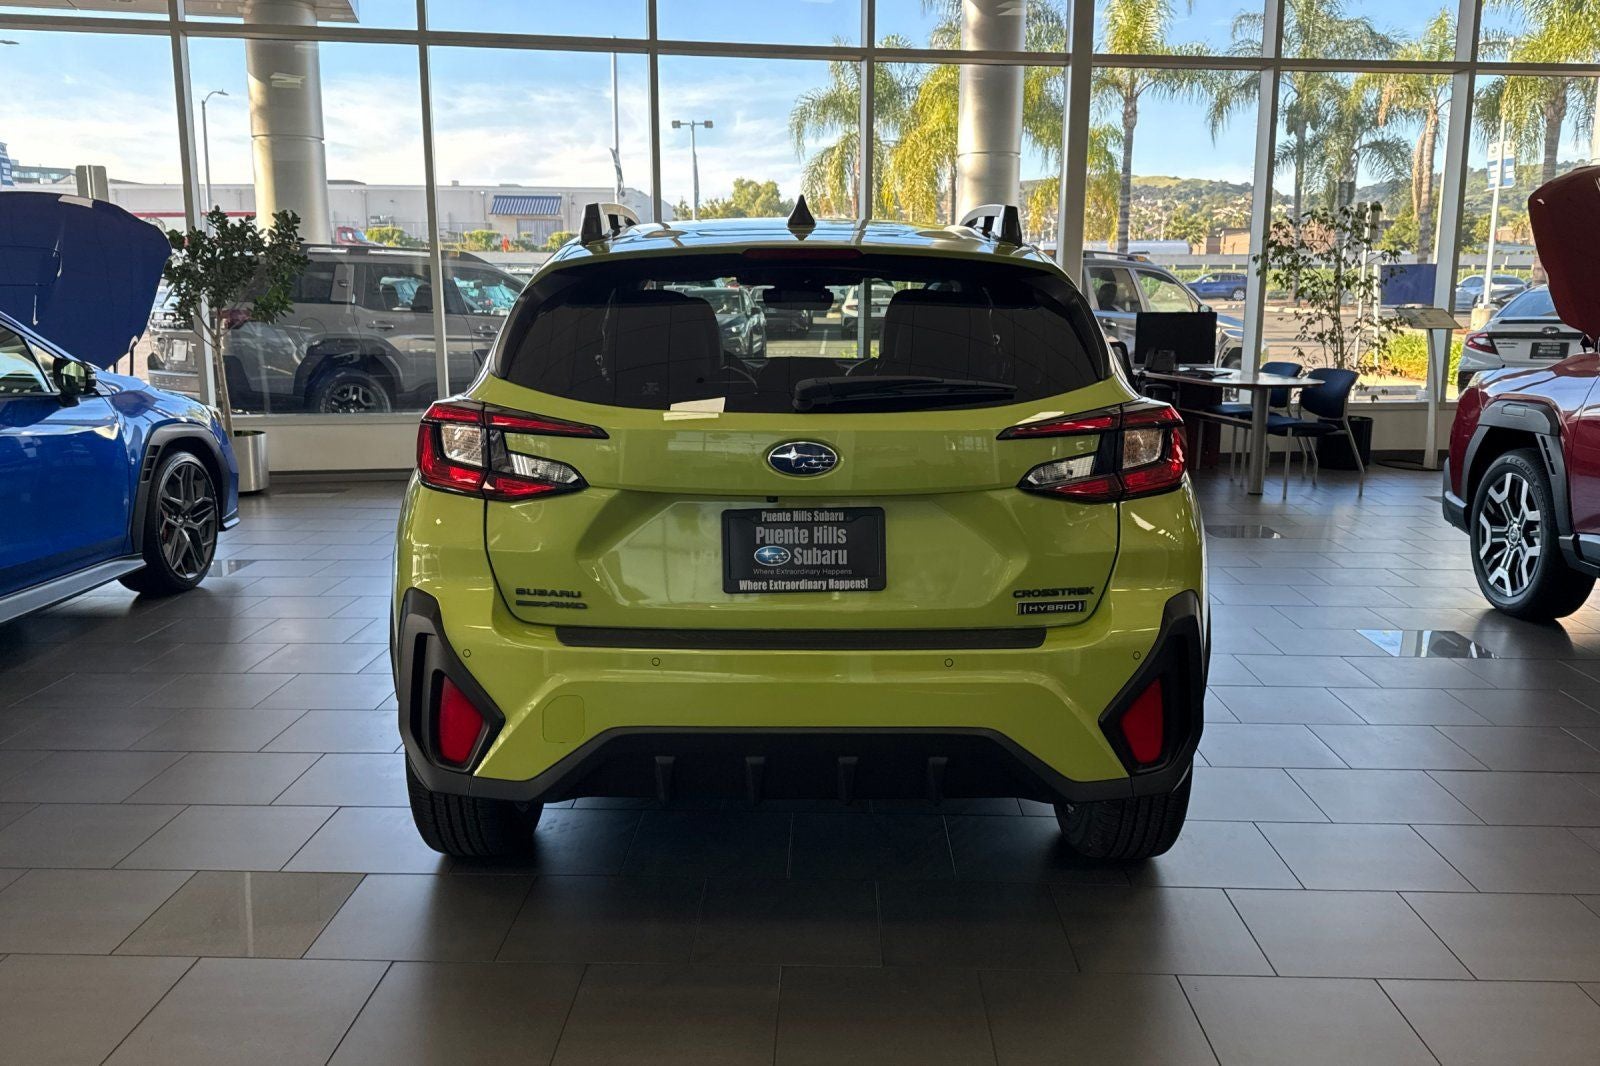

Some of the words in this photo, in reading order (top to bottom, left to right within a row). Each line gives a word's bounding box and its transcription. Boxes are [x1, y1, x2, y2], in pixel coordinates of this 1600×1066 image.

[762, 511, 791, 522] Puente
[793, 511, 812, 522] Hills
[814, 511, 844, 522] Subaru
[755, 526, 809, 545] Puente
[813, 525, 847, 544] Hills
[793, 547, 848, 565] Subaru
[776, 568, 821, 576] Extraordinary
[739, 579, 767, 591] Where
[769, 579, 827, 591] Extraordinary
[828, 578, 869, 590] Happens!
[515, 588, 582, 598] SUBARU
[1013, 587, 1094, 598] CROSSTREK
[1029, 603, 1076, 612] HYBRID
